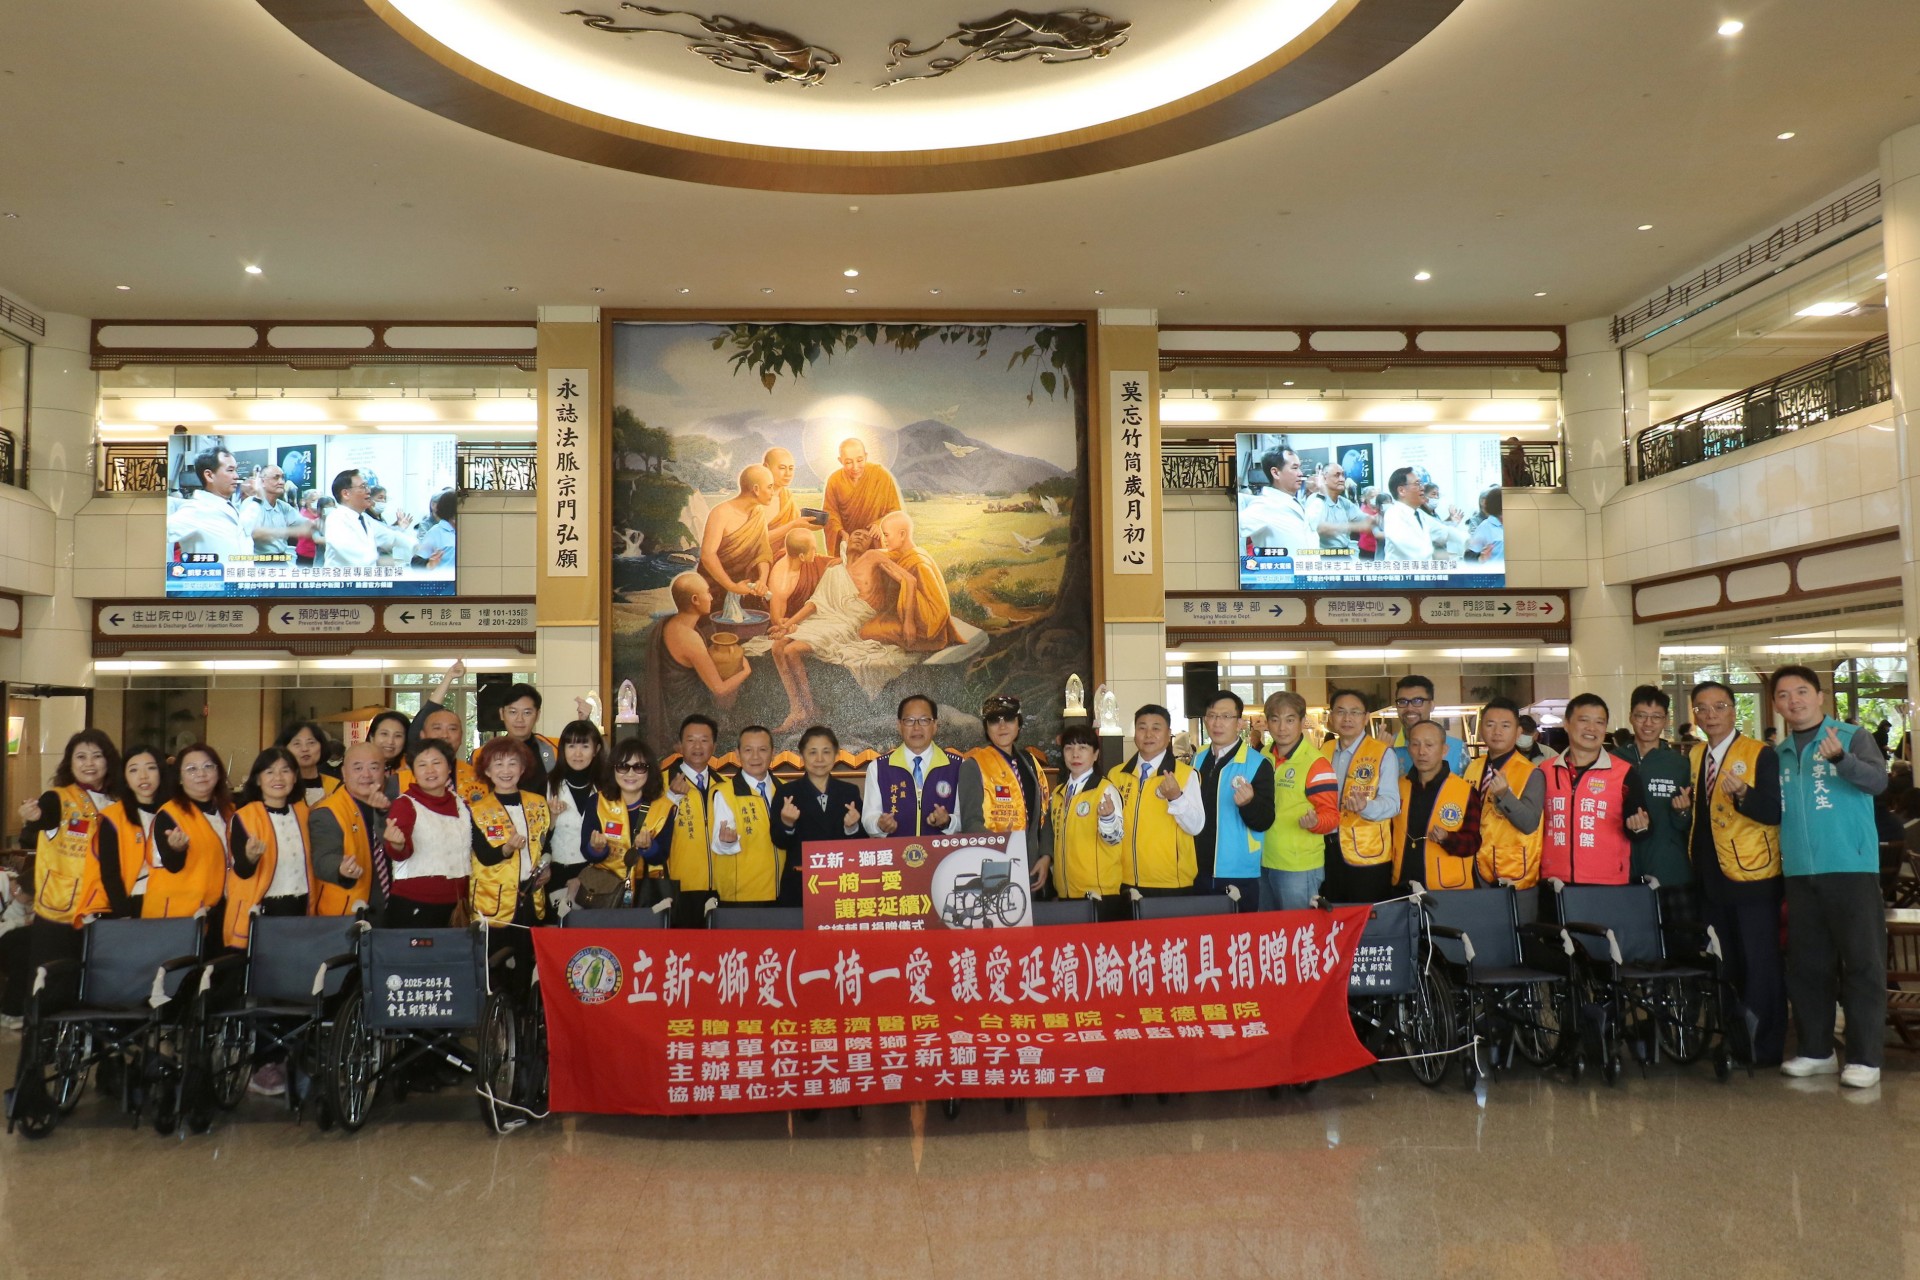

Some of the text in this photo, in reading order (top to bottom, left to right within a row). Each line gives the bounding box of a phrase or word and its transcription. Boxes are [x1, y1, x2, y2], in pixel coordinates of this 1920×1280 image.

[555, 378, 580, 569] 永誌法脈宗門弘願
[1120, 381, 1145, 565] 莫忘竹筒歲月初心
[1183, 602, 1260, 612] 影像醫學部
[1328, 600, 1385, 612] 預防醫學中心
[1463, 600, 1495, 611] 門診區
[1516, 600, 1537, 610] 急診
[132, 610, 244, 622] 住出院中心/注射室
[298, 608, 360, 620] 預防醫學中心
[421, 608, 471, 620] 門診區
[1552, 796, 1566, 846] 何欣純
[1579, 798, 1596, 848] 徐俊傑
[404, 977, 452, 988] 2025-26年度
[387, 990, 453, 1002] 大里立新獅子會
[387, 1003, 406, 1016] 會長
